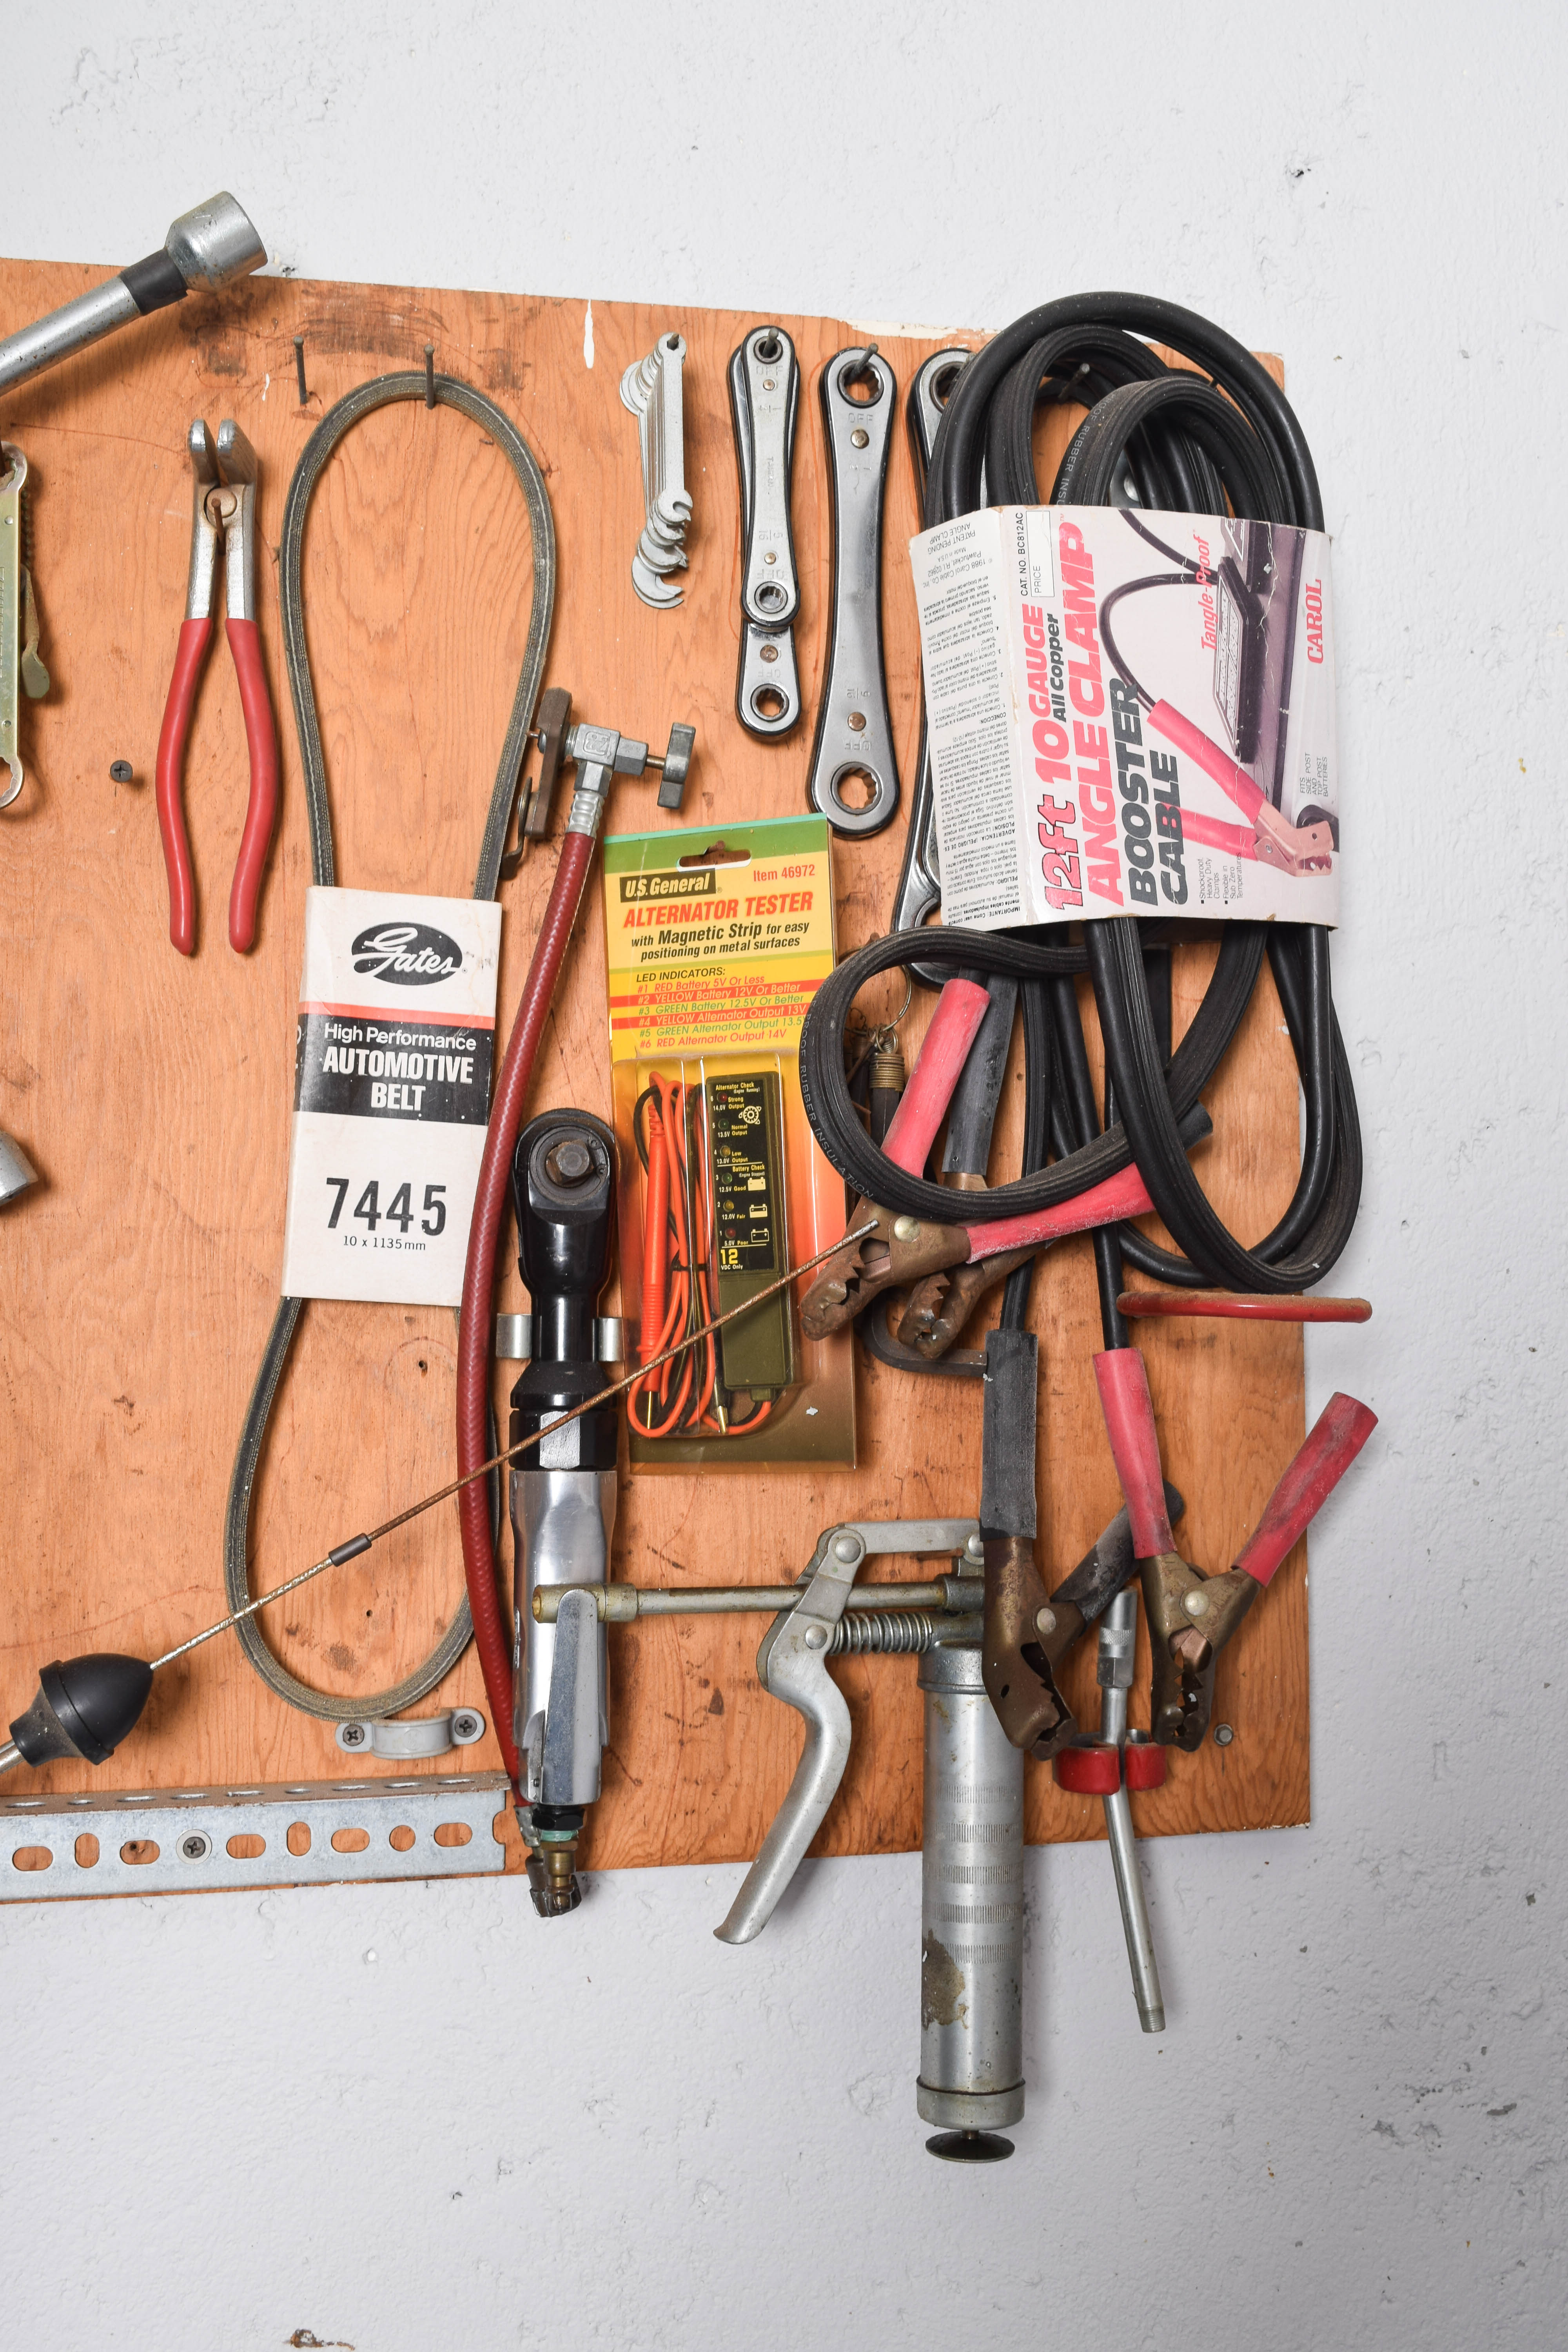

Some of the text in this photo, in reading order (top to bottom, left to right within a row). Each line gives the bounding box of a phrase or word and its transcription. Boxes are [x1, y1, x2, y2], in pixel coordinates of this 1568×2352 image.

[848, 413, 873, 425] OFF
[1065, 425, 1090, 472] RUBBER
[927, 530, 975, 555] PATENT PENDING
[929, 522, 970, 544] ANGLE CLAMP
[1015, 513, 1025, 554] BC812AC
[757, 569, 785, 580] OFF
[927, 565, 942, 577] 02862
[940, 570, 954, 580] Cable
[955, 564, 970, 575] Carol
[971, 559, 985, 569] 1988
[1020, 577, 1028, 596] CAT.
[1033, 566, 1042, 593] PRICE
[1193, 535, 1220, 650] Tangle-Proof
[1305, 579, 1323, 664] CAROL
[757, 668, 781, 678] OFF
[1047, 613, 1066, 724] All Copper
[1059, 523, 1123, 904] ANGLE CLAMP
[844, 739, 872, 751] OFF
[1022, 604, 1082, 908] 12ft 10 GAUGE
[1110, 677, 1157, 904] BOOSTER
[1148, 750, 1188, 906] CABLE
[753, 864, 815, 882] Item 46972
[1234, 852, 1243, 898] Temperatures
[624, 891, 813, 927] ALTERNATOR TESTER
[632, 922, 809, 947] with Magnetic Strip for easy
[353, 928, 461, 979] Gates
[641, 937, 800, 962] positioning on metal surfaces
[636, 967, 725, 982] LED INDICATORS:
[637, 976, 764, 995] #1 RED Battery 5V Or Less
[638, 983, 800, 1005] #2 YELLOW Battery 12V Or Better
[639, 995, 803, 1015] #3 GREEN Battery 12.5V Or Better
[639, 1004, 808, 1027] #4 YELLOW Alternator Output 13V
[639, 1028, 651, 1037] #5
[656, 1025, 689, 1036] GREEN
[692, 1022, 737, 1033] Alternator
[739, 1018, 779, 1029] Output
[323, 1023, 476, 1050] High Performance
[640, 1028, 787, 1048] #6 RED Alternator Output 14V
[323, 1046, 473, 1083] AUTOMOTIVE
[371, 1082, 426, 1111] BELT
[800, 1014, 873, 1200] PROOF RUBBER INSULATION
[327, 1178, 446, 1236] 7445
[344, 1236, 357, 1246] 10
[720, 1248, 738, 1265] 12
